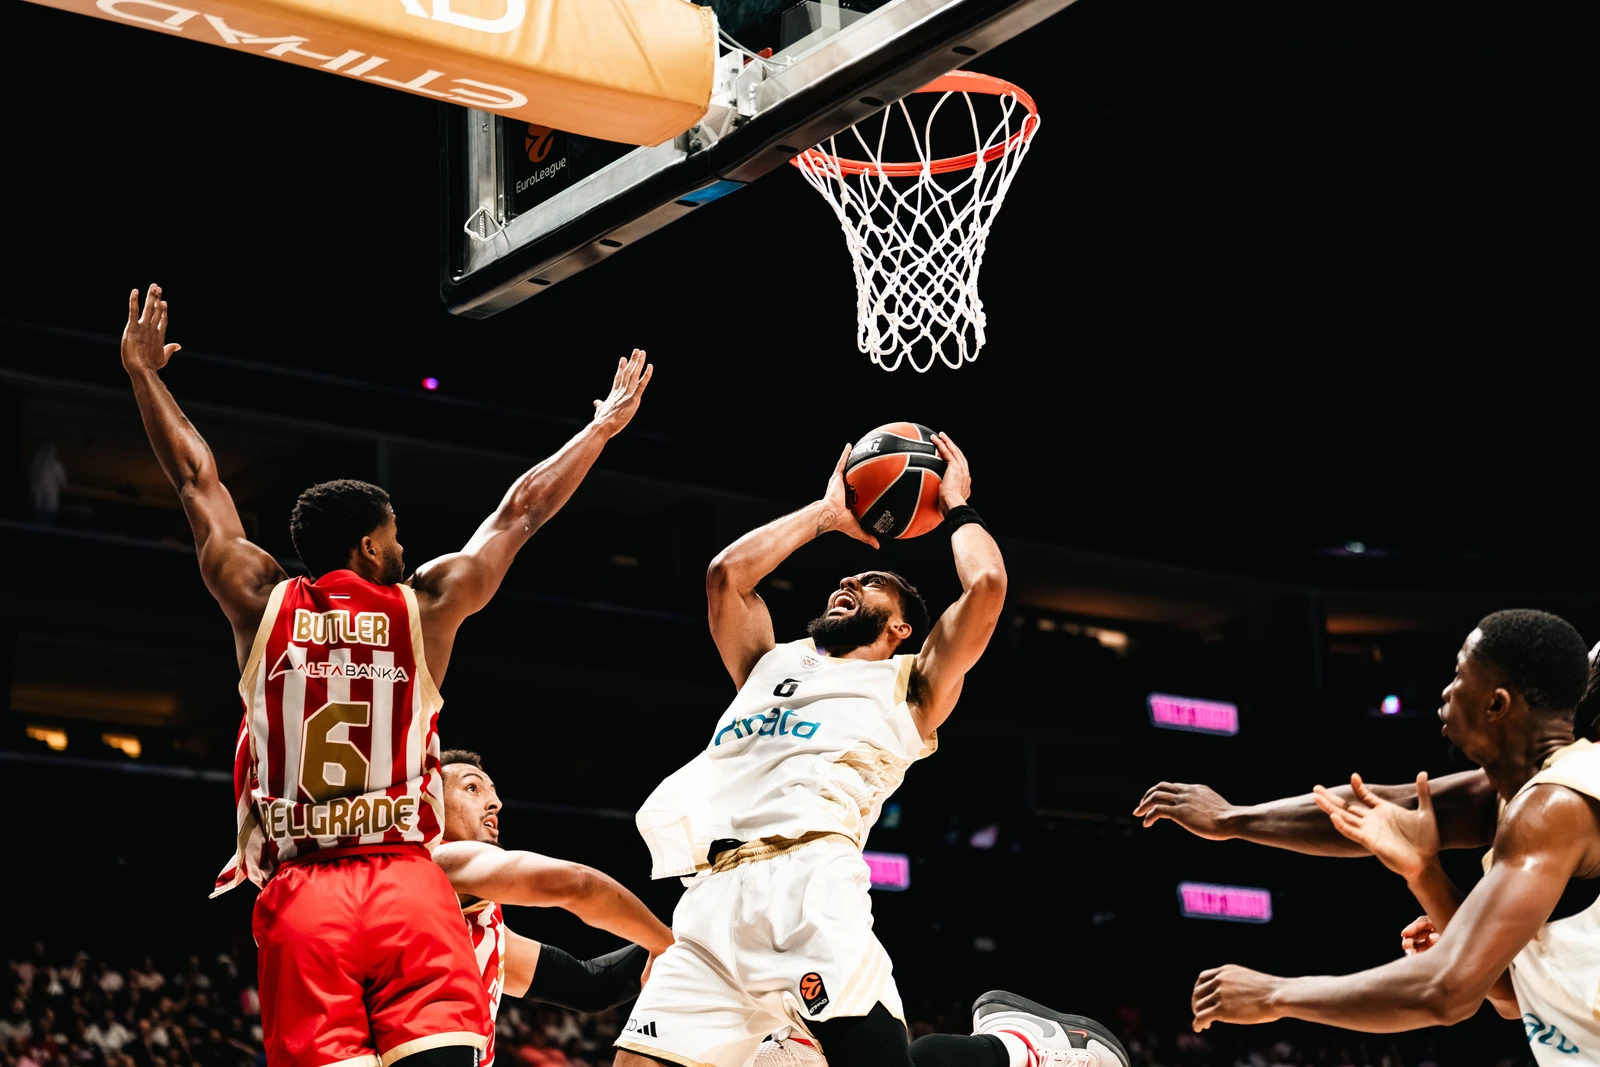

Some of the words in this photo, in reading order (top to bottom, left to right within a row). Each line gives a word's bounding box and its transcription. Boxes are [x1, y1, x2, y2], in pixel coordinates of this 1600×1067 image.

[96, 0, 528, 109] ETIHAD
[516, 157, 567, 194] EuroLeague
[294, 609, 389, 645] BUTLER
[773, 678, 803, 698] 6
[299, 701, 370, 803] 6
[260, 796, 415, 840] BELGRADE
